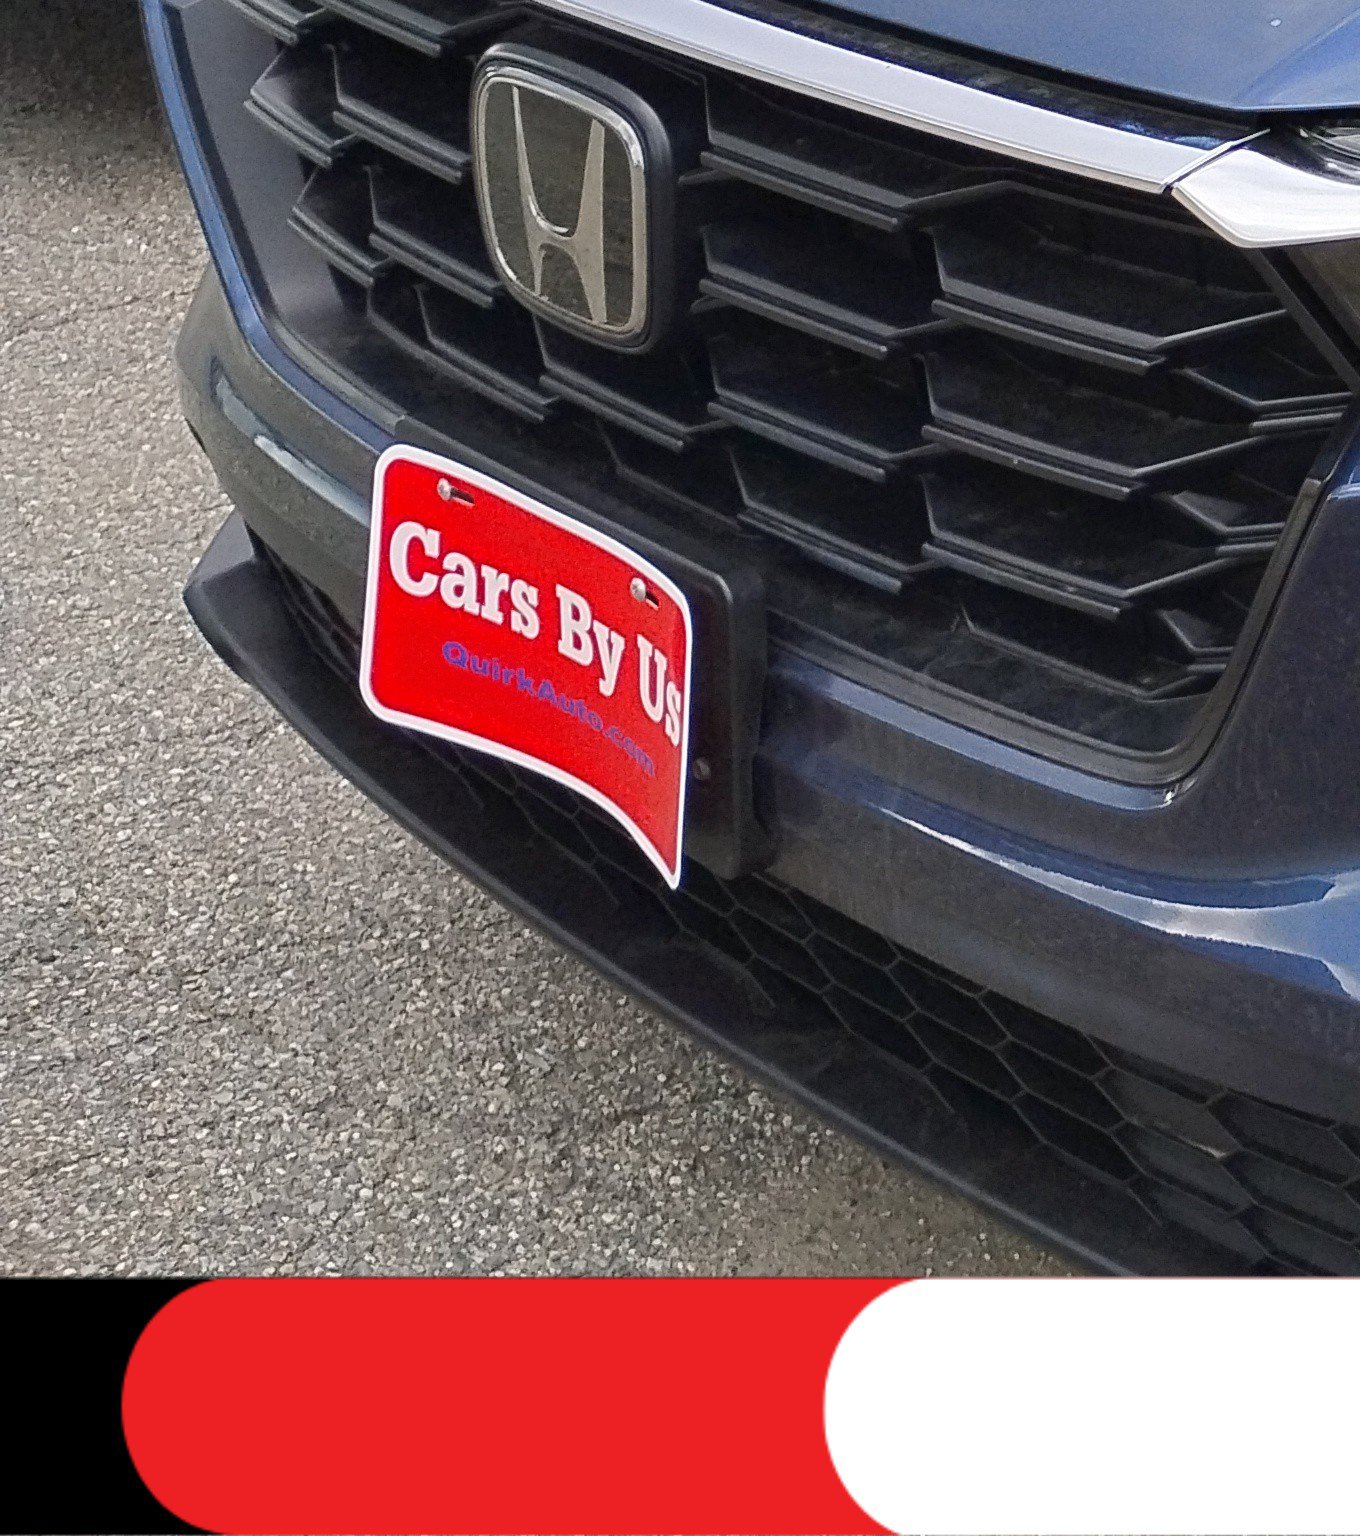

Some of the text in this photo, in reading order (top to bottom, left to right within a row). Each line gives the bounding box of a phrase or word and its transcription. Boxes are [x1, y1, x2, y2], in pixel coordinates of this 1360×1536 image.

[389, 520, 682, 747] Cars By Us
[441, 641, 656, 777] QuirkAuto.com
